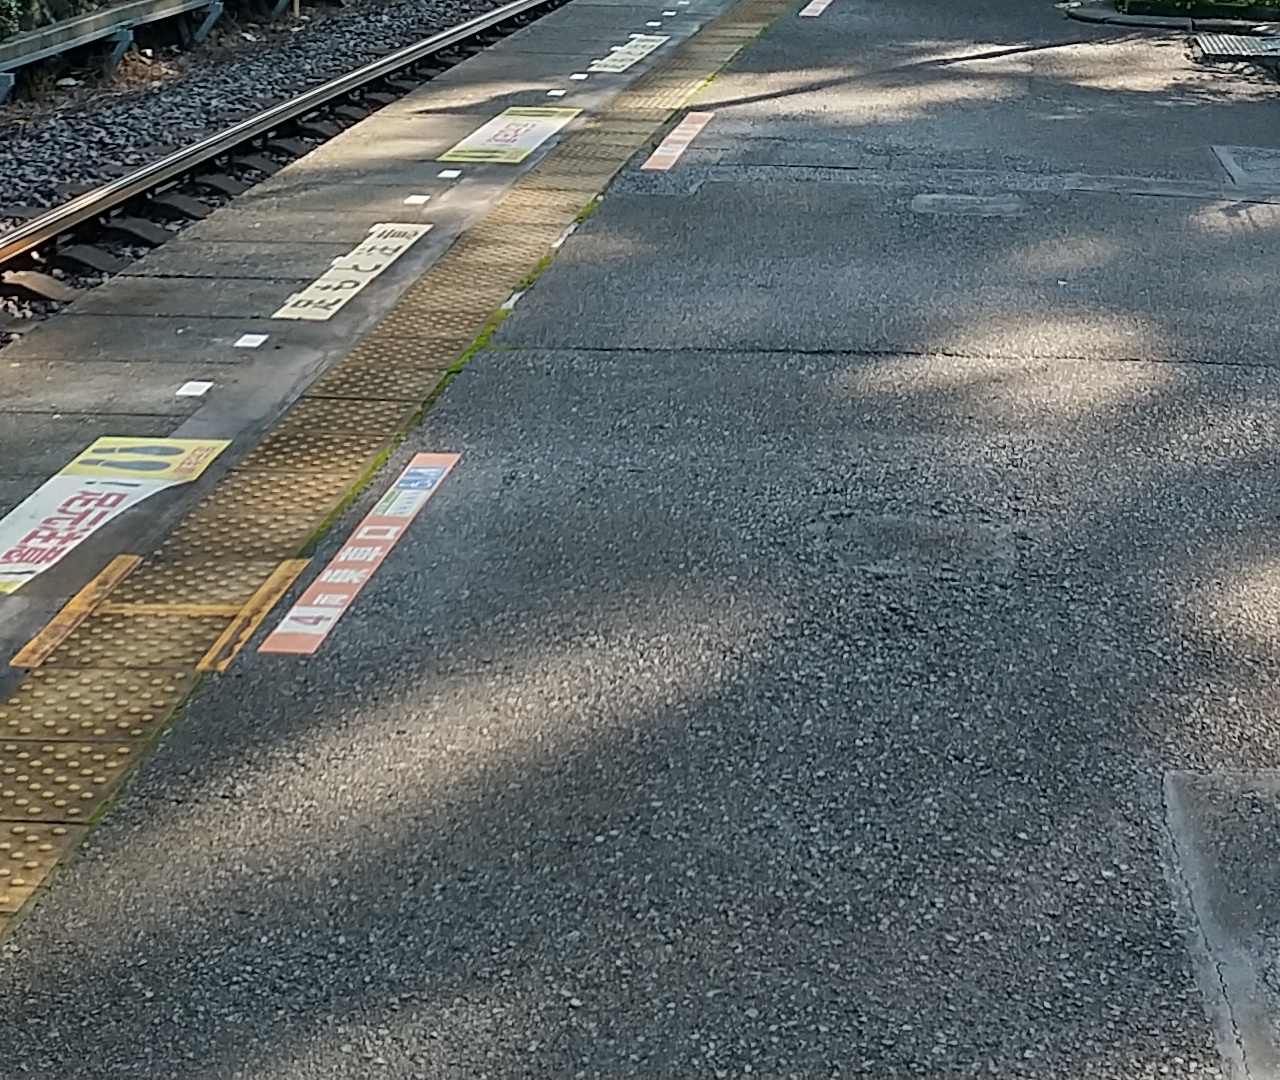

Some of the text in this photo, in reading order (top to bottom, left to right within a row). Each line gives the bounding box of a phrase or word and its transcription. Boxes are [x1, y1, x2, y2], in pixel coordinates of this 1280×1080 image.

[290, 228, 419, 311] 足もと注意
